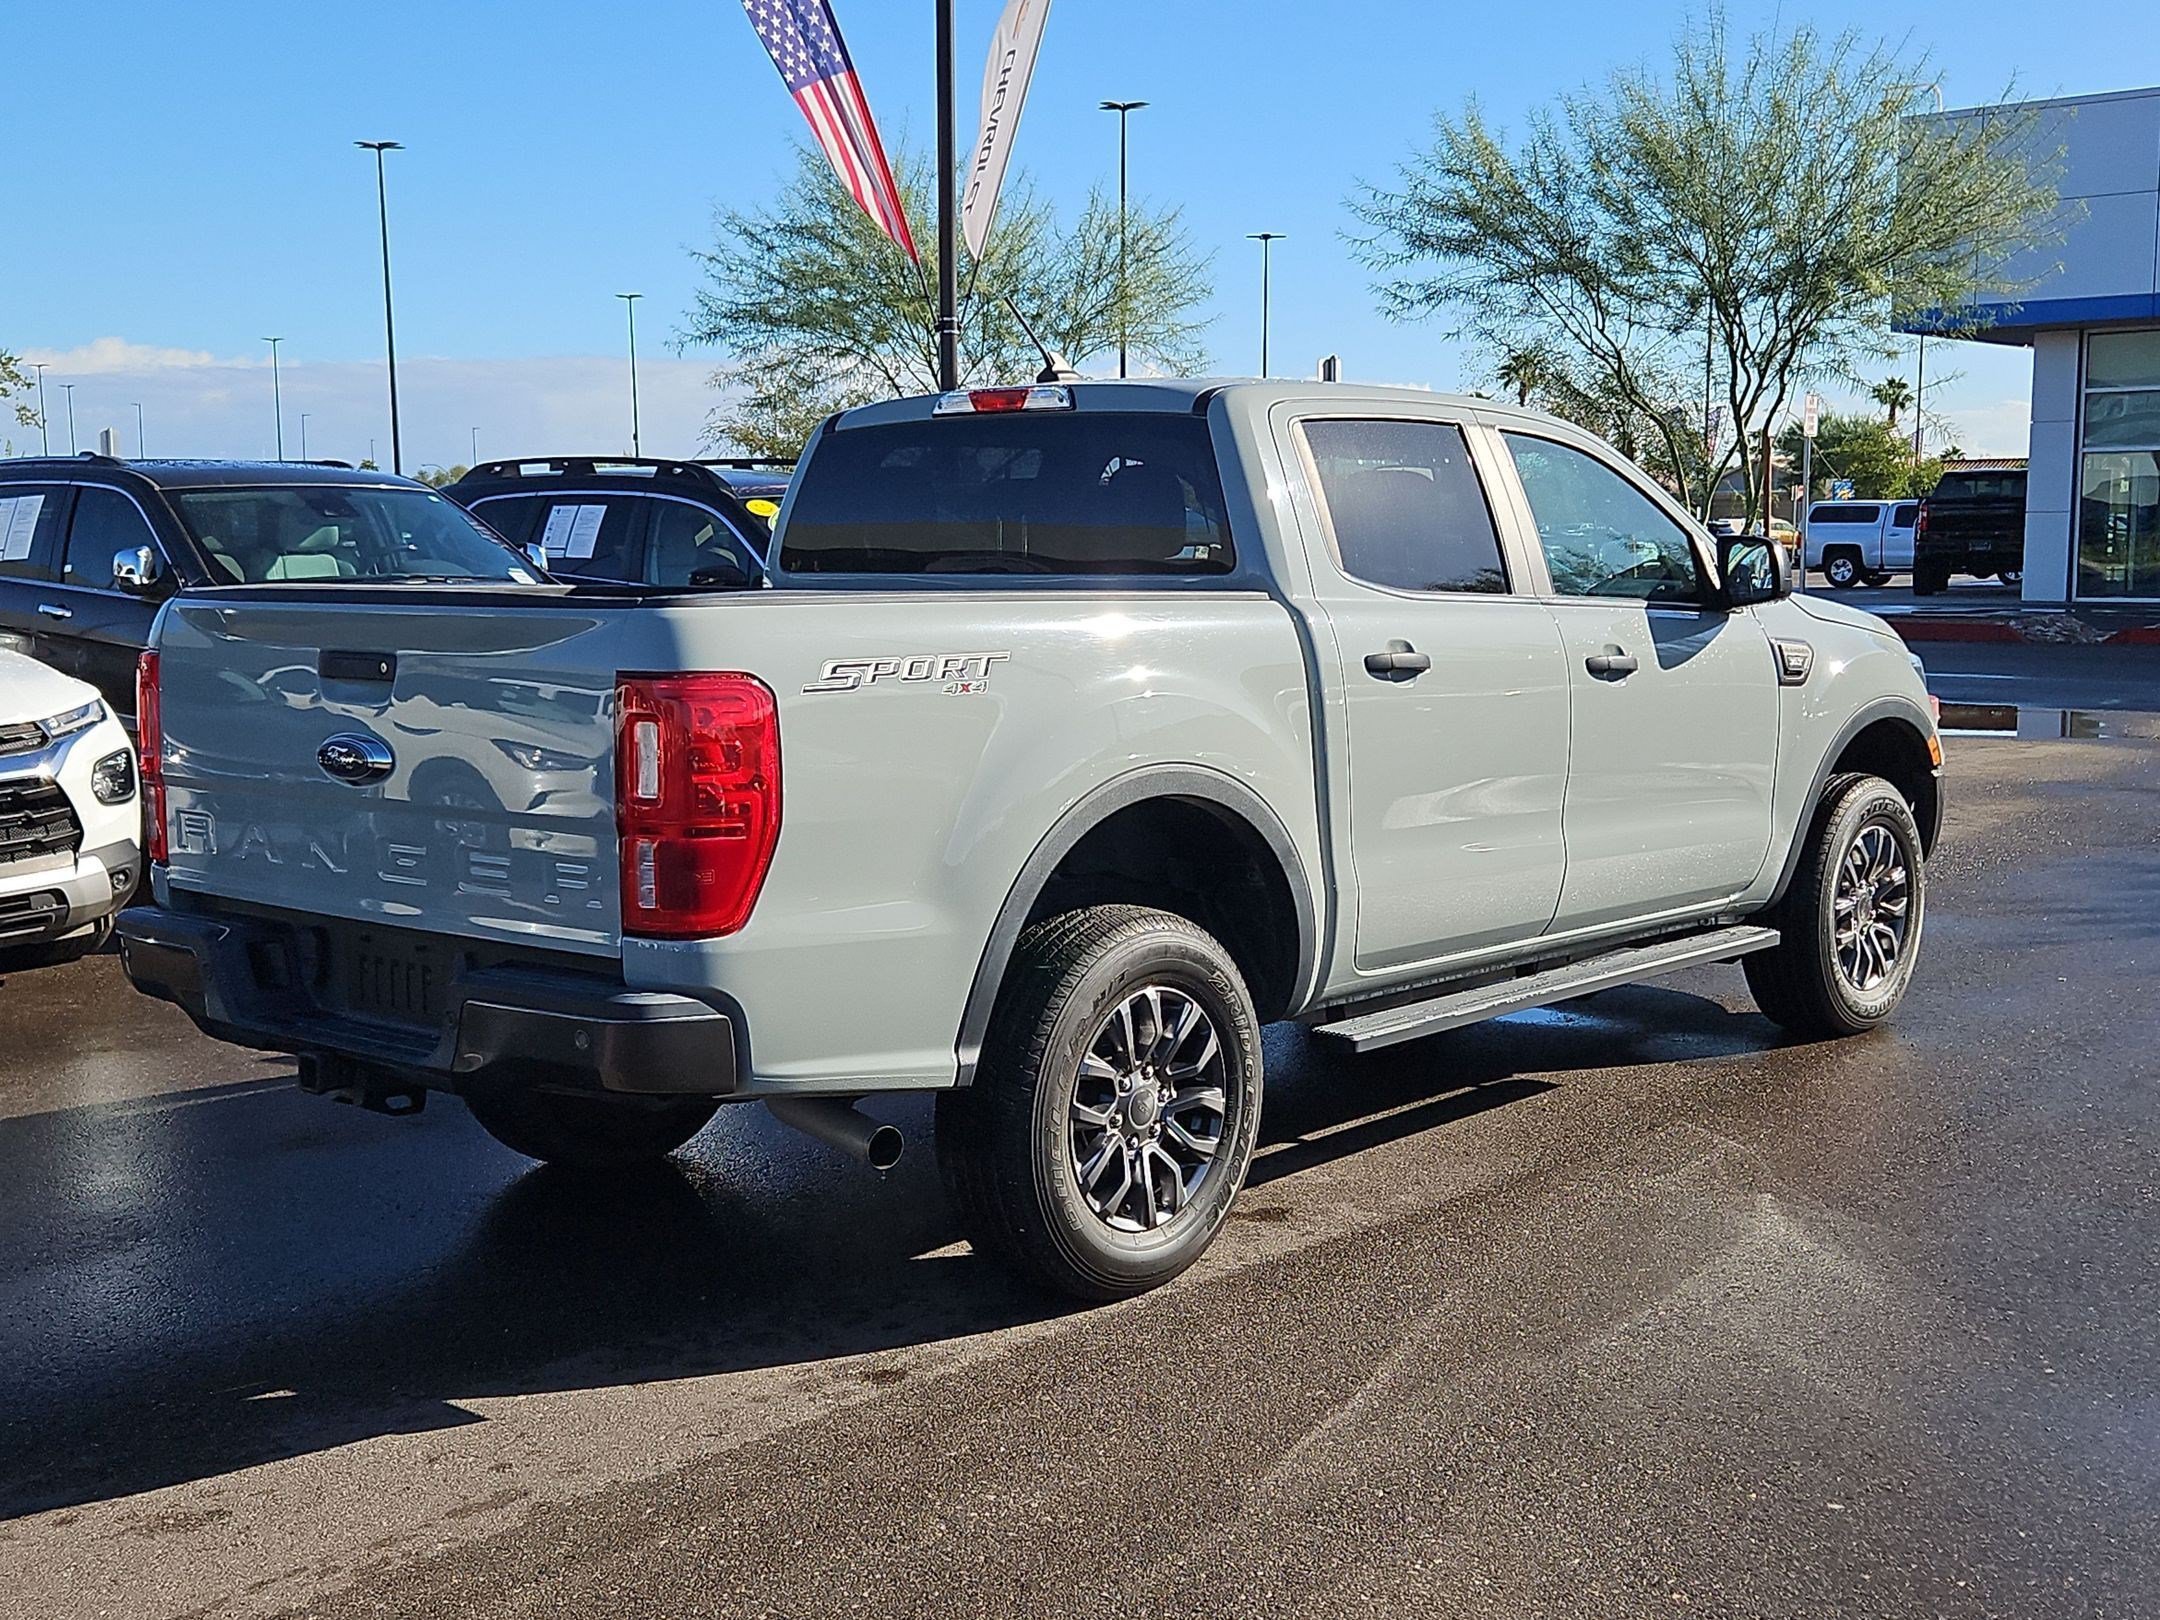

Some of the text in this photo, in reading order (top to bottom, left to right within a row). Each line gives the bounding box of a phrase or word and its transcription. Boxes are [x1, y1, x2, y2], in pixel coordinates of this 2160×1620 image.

[964, 48, 1017, 215] CHEVROLET
[800, 650, 1012, 694] SPORT
[1207, 970, 1255, 1233] BRIDGESTONE
